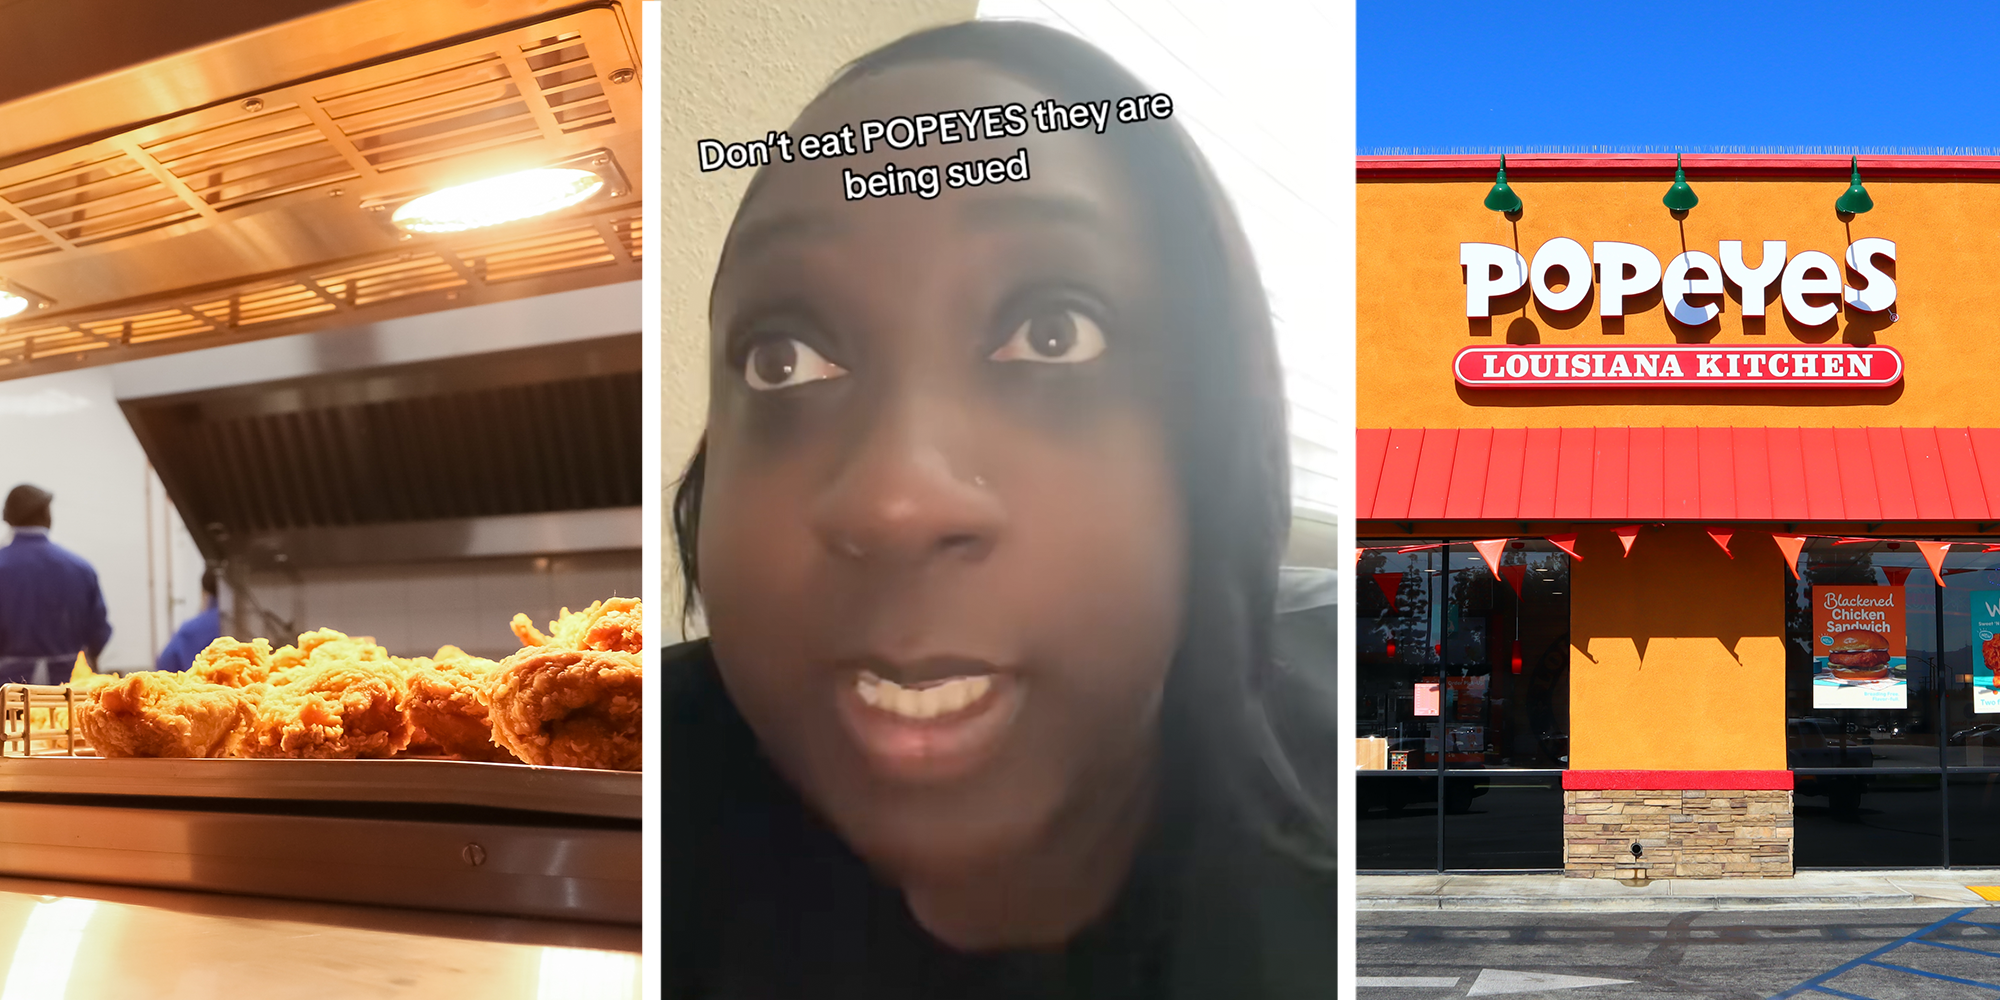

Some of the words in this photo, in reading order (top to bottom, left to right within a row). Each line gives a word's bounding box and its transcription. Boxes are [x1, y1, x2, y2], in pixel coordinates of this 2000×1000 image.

[1483, 354, 1684, 378] LOUISIANA
[1696, 354, 1874, 378] KITCHEN
[1824, 592, 1895, 610] Blackened
[1831, 609, 1885, 621] Chicken
[1826, 620, 1891, 633] Sandwich
[1981, 698, 1995, 706] Two
